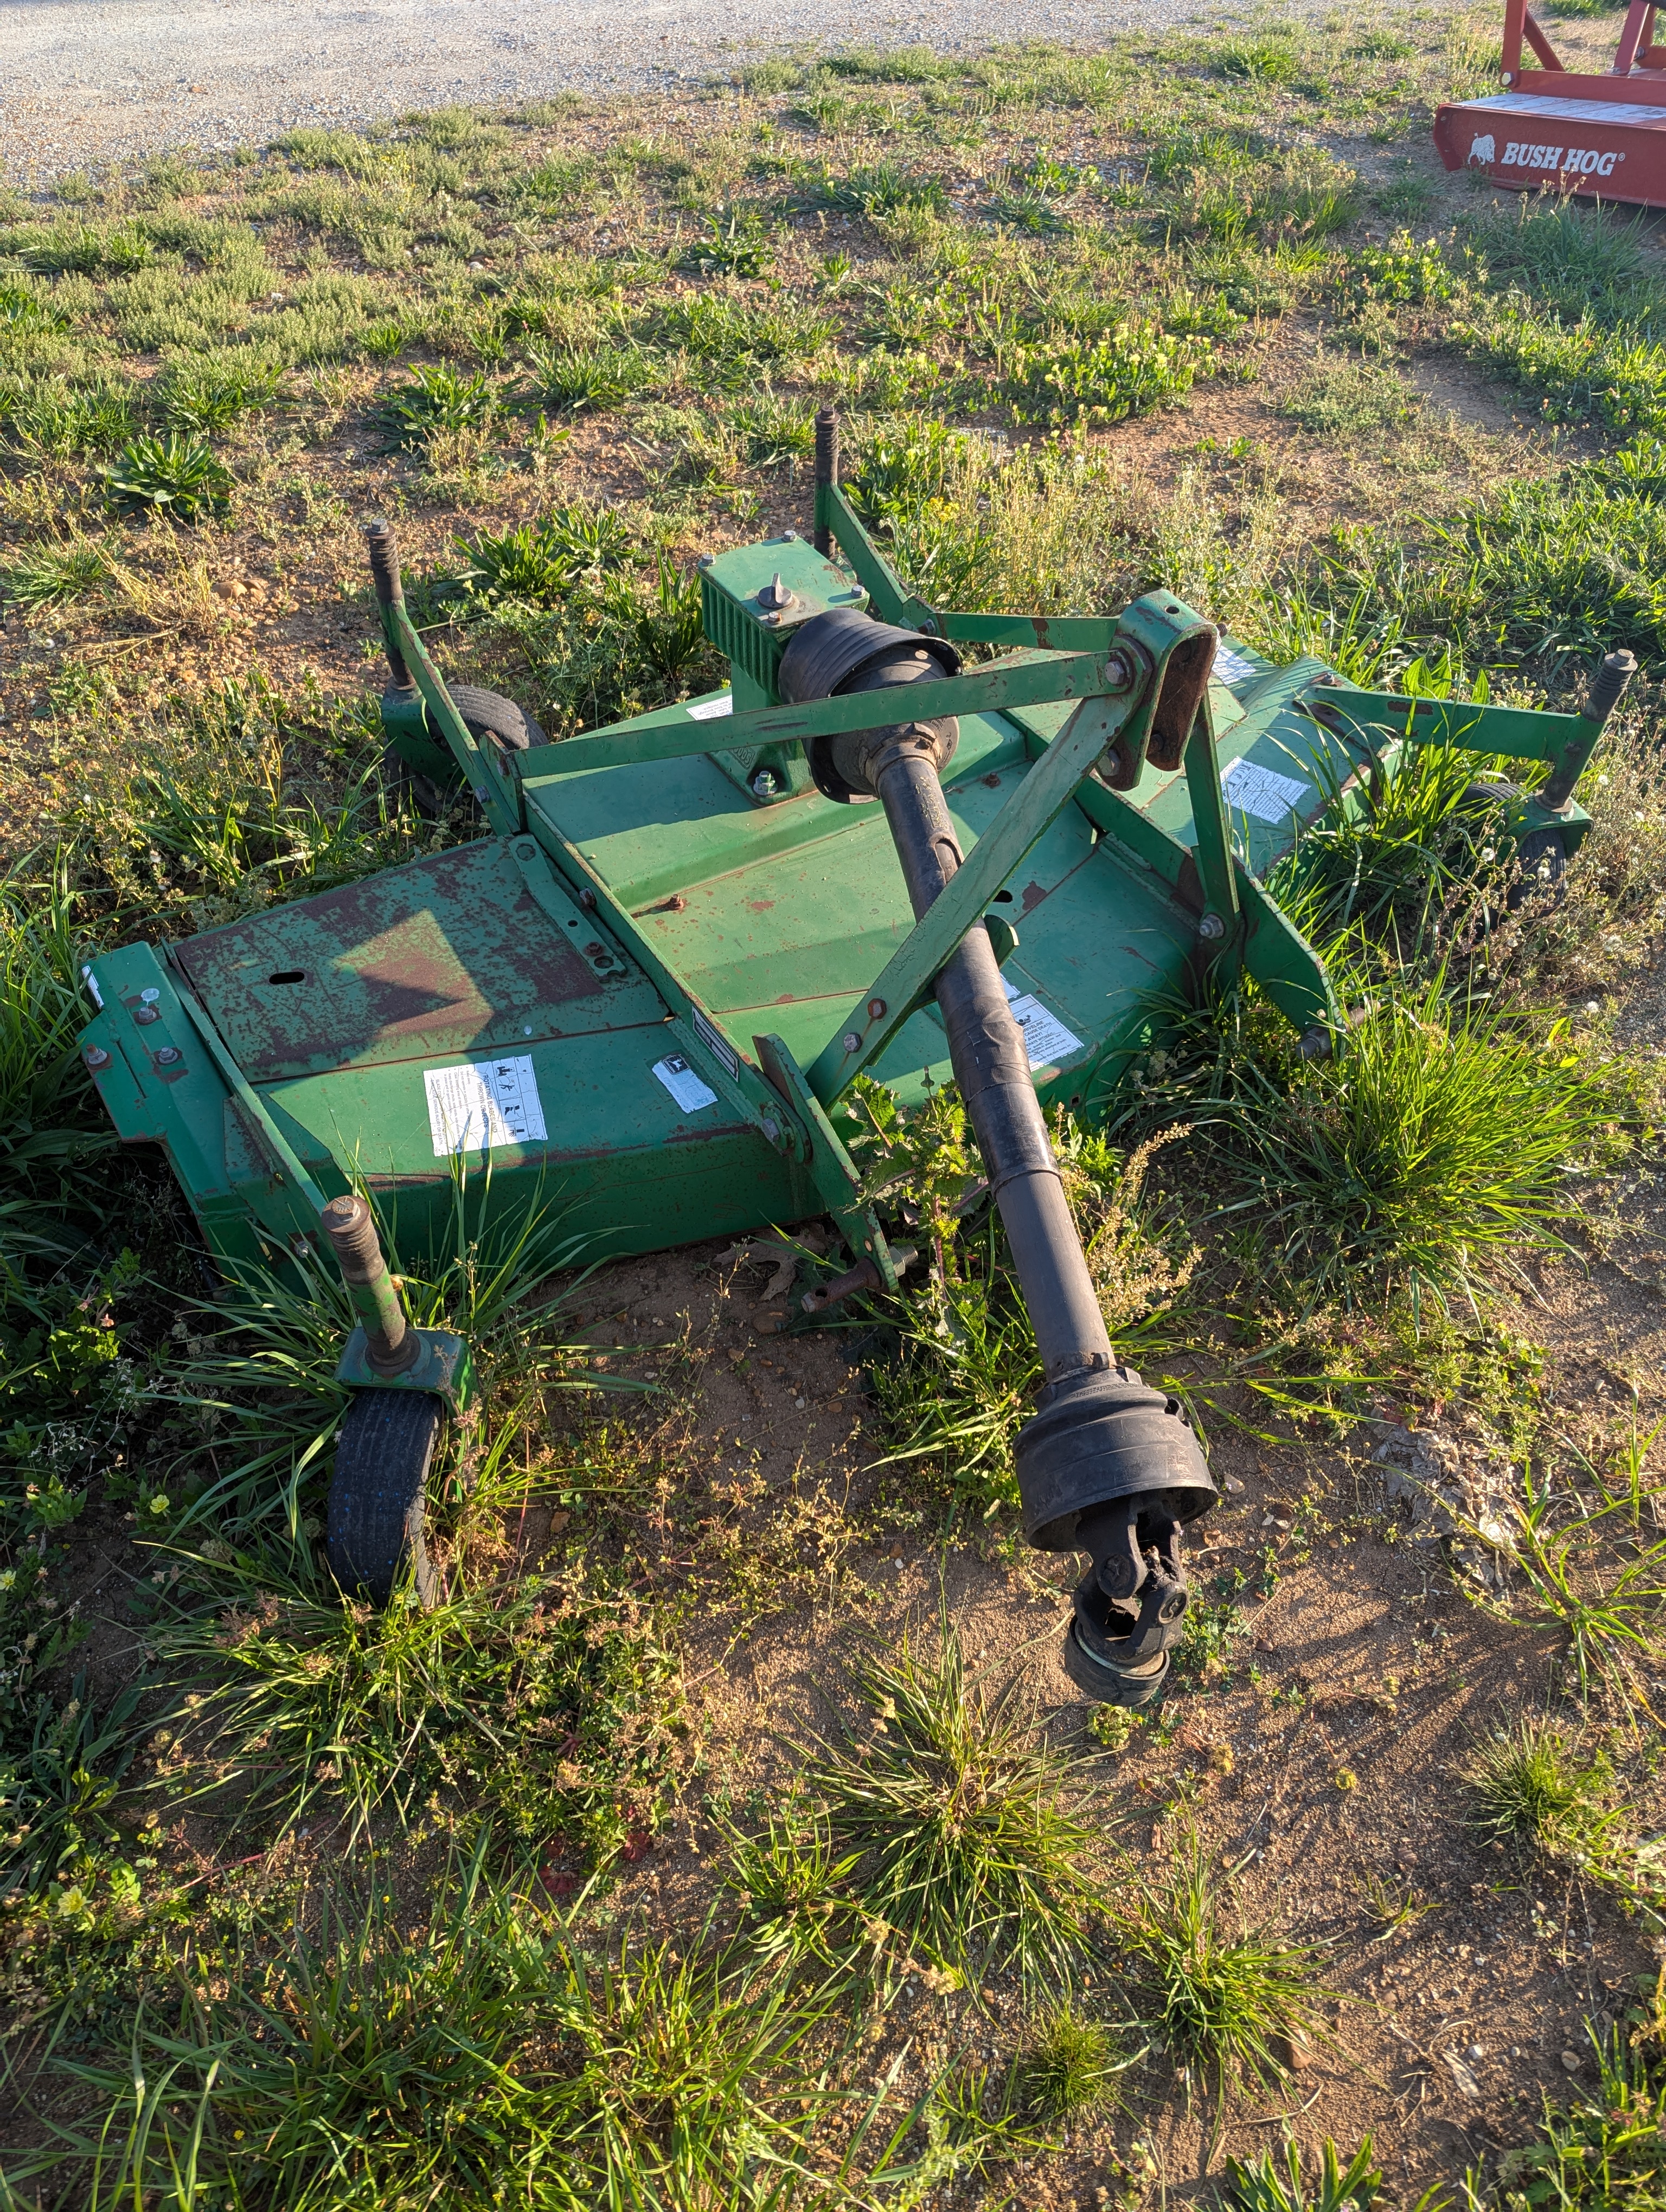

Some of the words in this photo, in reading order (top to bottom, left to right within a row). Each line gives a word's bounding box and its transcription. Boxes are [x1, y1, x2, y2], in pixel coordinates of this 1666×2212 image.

[1502, 142, 1564, 169] BUSH
[1023, 1027, 1039, 1037] CAUSE
[1037, 1021, 1052, 1030] DEATH
[1027, 1031, 1043, 1041] AWAY!
[1025, 1039, 1038, 1047] ERATE
[476, 1082, 485, 1104] THROWN
[482, 1075, 492, 1099] ROTATING
[487, 1101, 496, 1121] BLADES
[480, 1105, 489, 1128] OBJECTS
